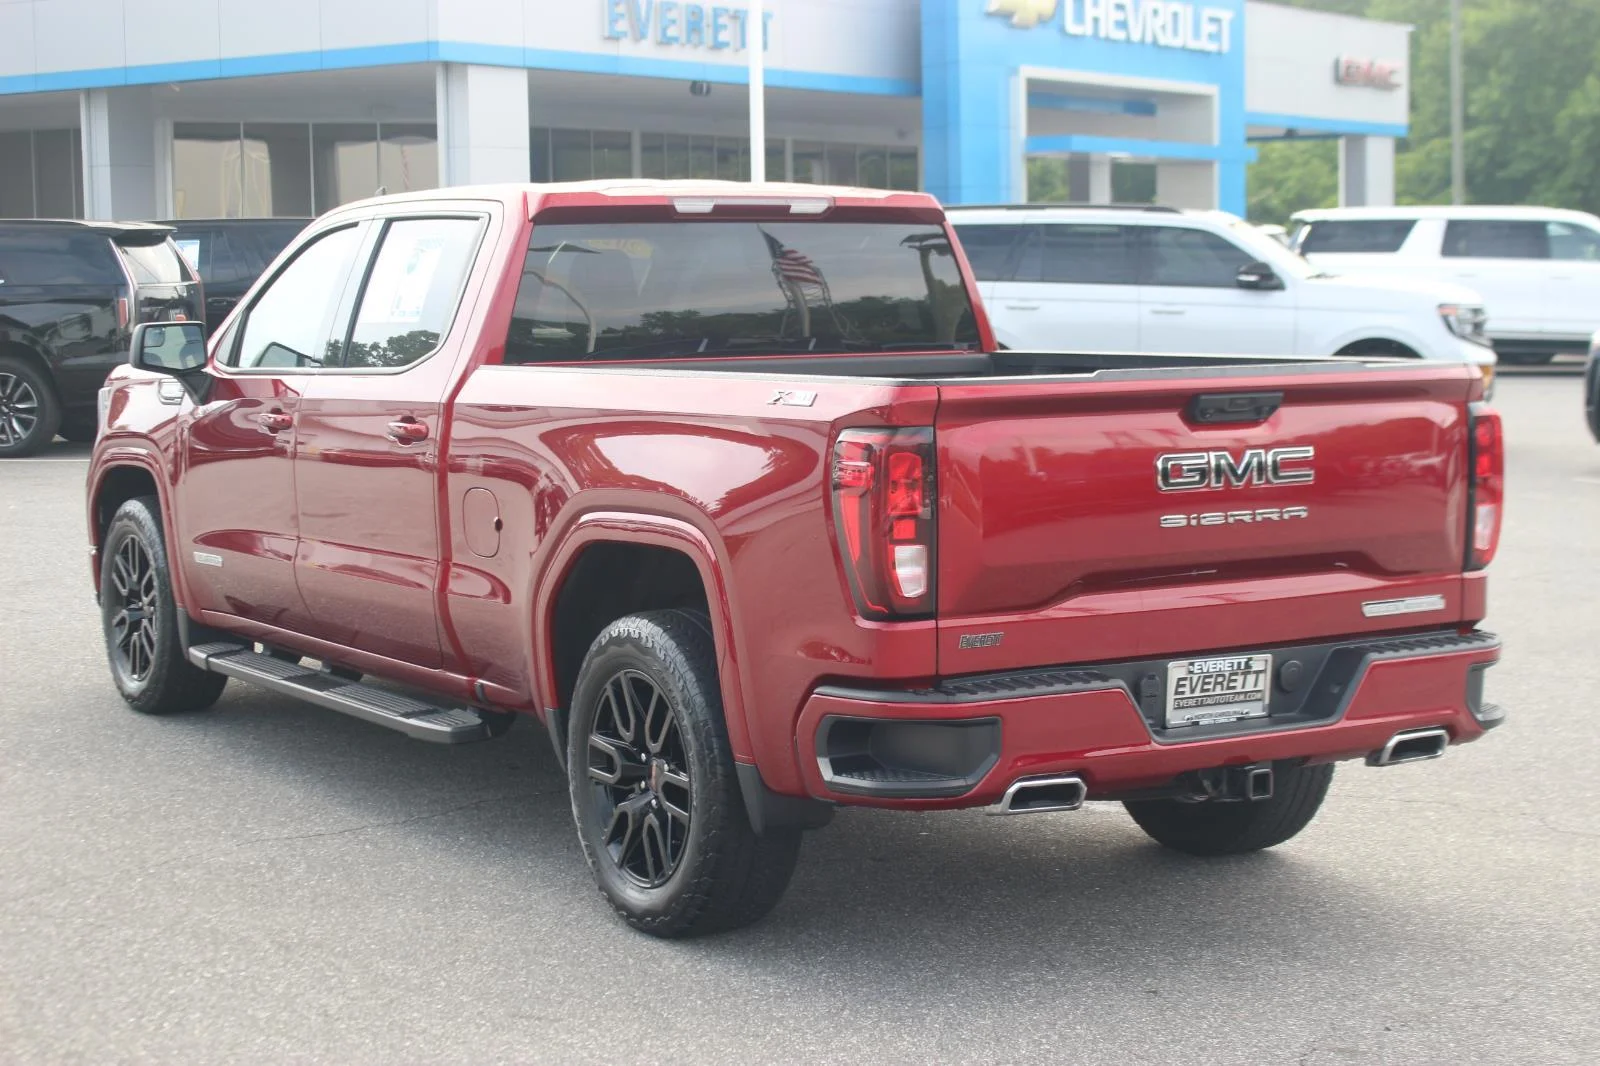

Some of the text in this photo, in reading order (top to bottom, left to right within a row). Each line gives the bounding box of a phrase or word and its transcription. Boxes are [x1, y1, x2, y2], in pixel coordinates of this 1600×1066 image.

[1063, 0, 1235, 54] CHEVROLET
[1156, 446, 1315, 492] GMC
[1160, 506, 1308, 527] SIERRA
[959, 631, 1004, 649] EVERETT
[1193, 659, 1247, 674] EVERETT
[1174, 670, 1266, 696] EVERETT
